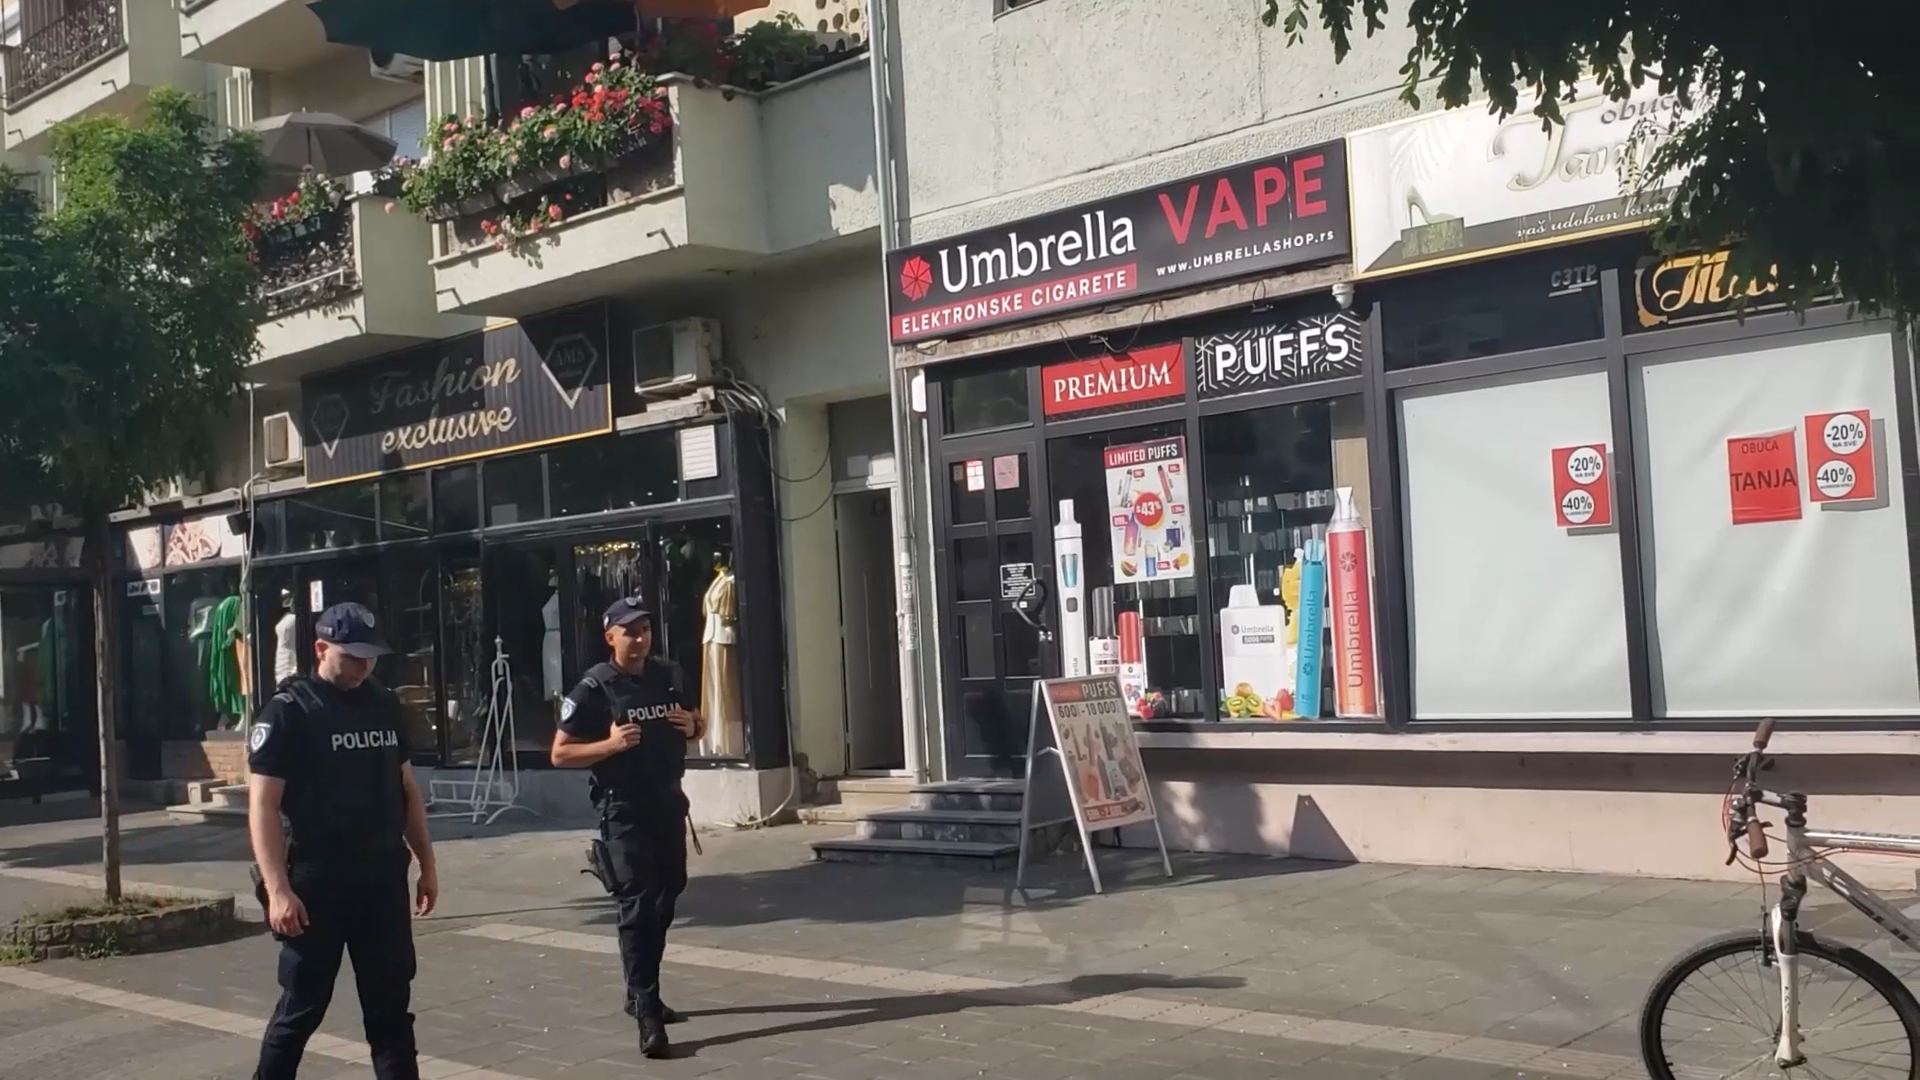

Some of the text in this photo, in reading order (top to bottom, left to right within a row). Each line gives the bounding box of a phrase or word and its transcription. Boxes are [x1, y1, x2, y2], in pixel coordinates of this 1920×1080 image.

[1158, 154, 1328, 244] VAPE
[1515, 188, 1680, 239] vaš udoban kora
[938, 210, 1137, 294] Umbrella
[1155, 230, 1335, 277] www.UMBRELLASHOP.rs
[900, 269, 1128, 335] ELEKTRONSKE CIGARETE
[1215, 323, 1350, 381] PUFFS
[368, 353, 522, 416] Fashion
[1053, 361, 1172, 403] PREMIUM
[380, 401, 519, 455] exclusive
[1826, 422, 1864, 441] -20%
[1109, 443, 1178, 466] LIMITED PUFFS
[1569, 455, 1602, 472] -20%
[1817, 467, 1853, 483] -40%
[1561, 496, 1593, 510] -40%
[1730, 467, 1797, 492] TANJA
[1303, 589, 1318, 659] Umbrella
[1344, 590, 1364, 688] Umbrella
[1081, 681, 1117, 699] PUFFS
[331, 729, 399, 752] POLICIJA
